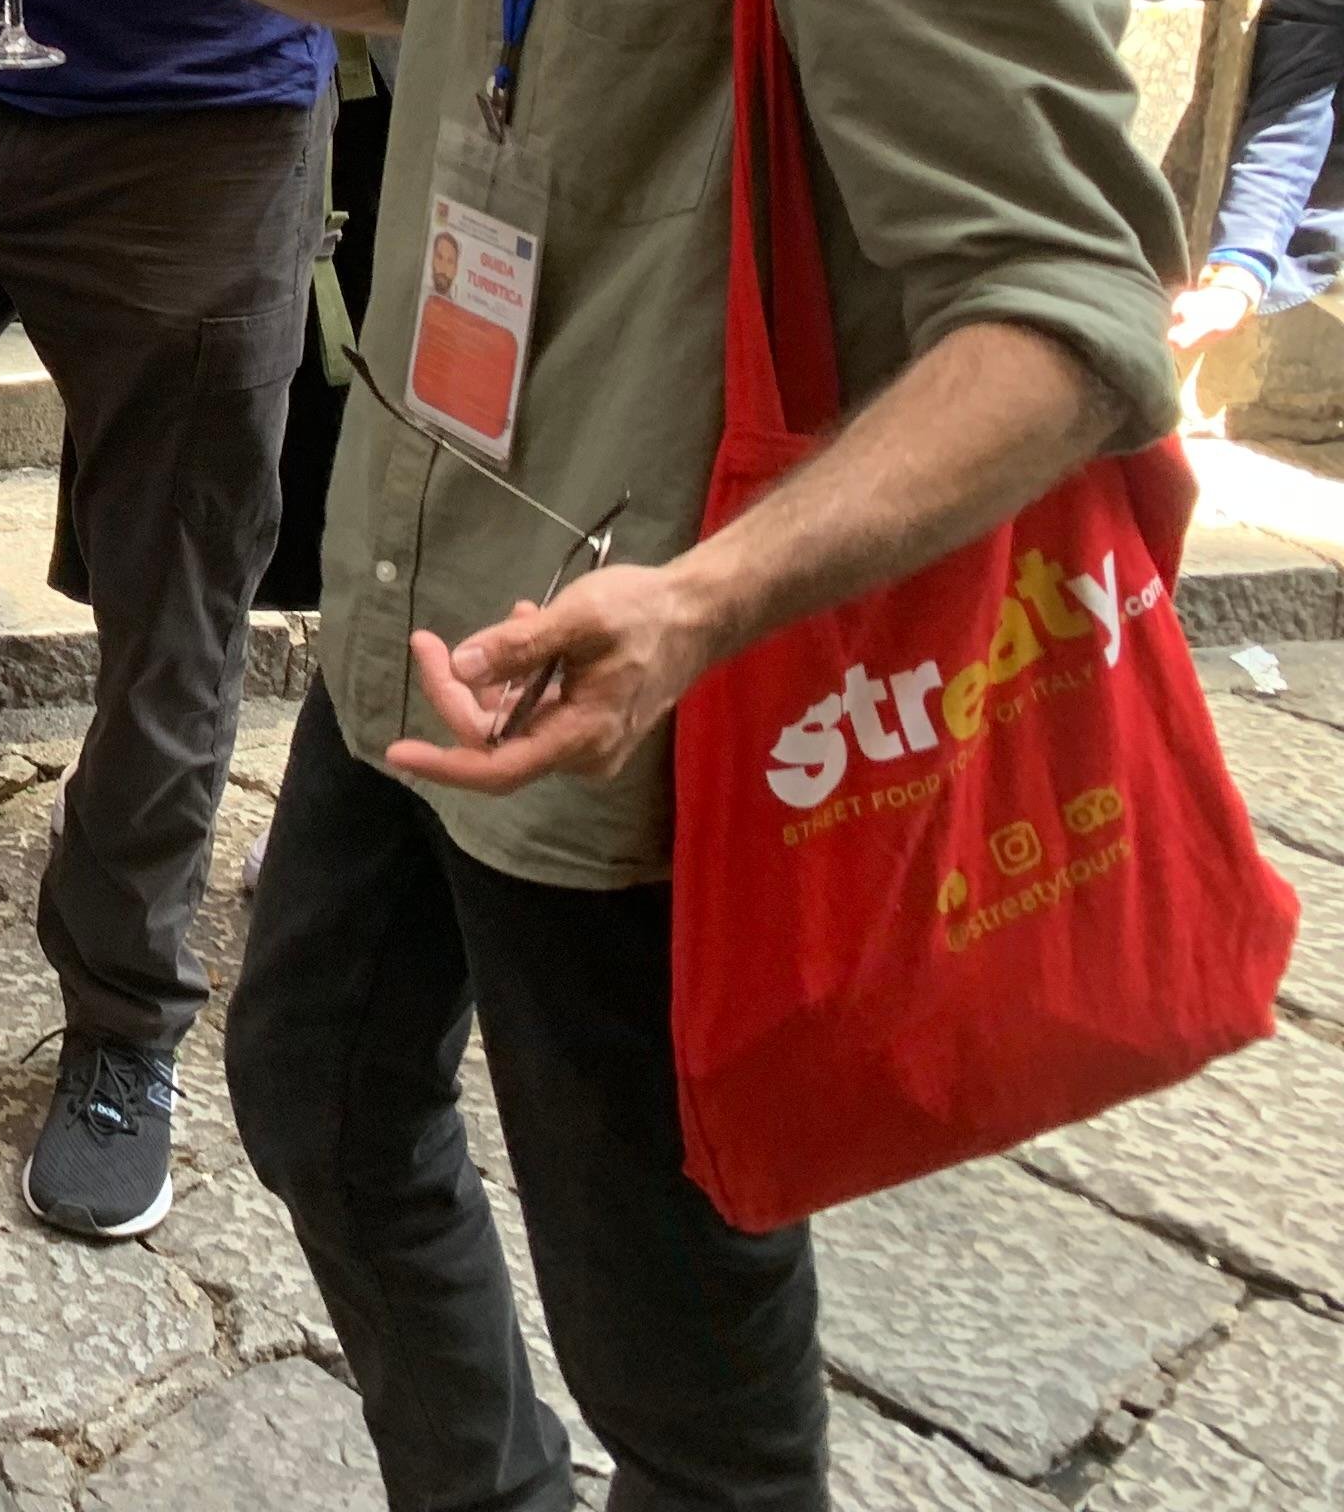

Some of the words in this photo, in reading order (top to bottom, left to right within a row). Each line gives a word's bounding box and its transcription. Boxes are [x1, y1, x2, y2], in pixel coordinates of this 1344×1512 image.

[479, 252, 516, 279] GUIDA
[467, 269, 524, 307] TURISTICA
[782, 795, 862, 847] STREET
[872, 773, 941, 810] FOOD
